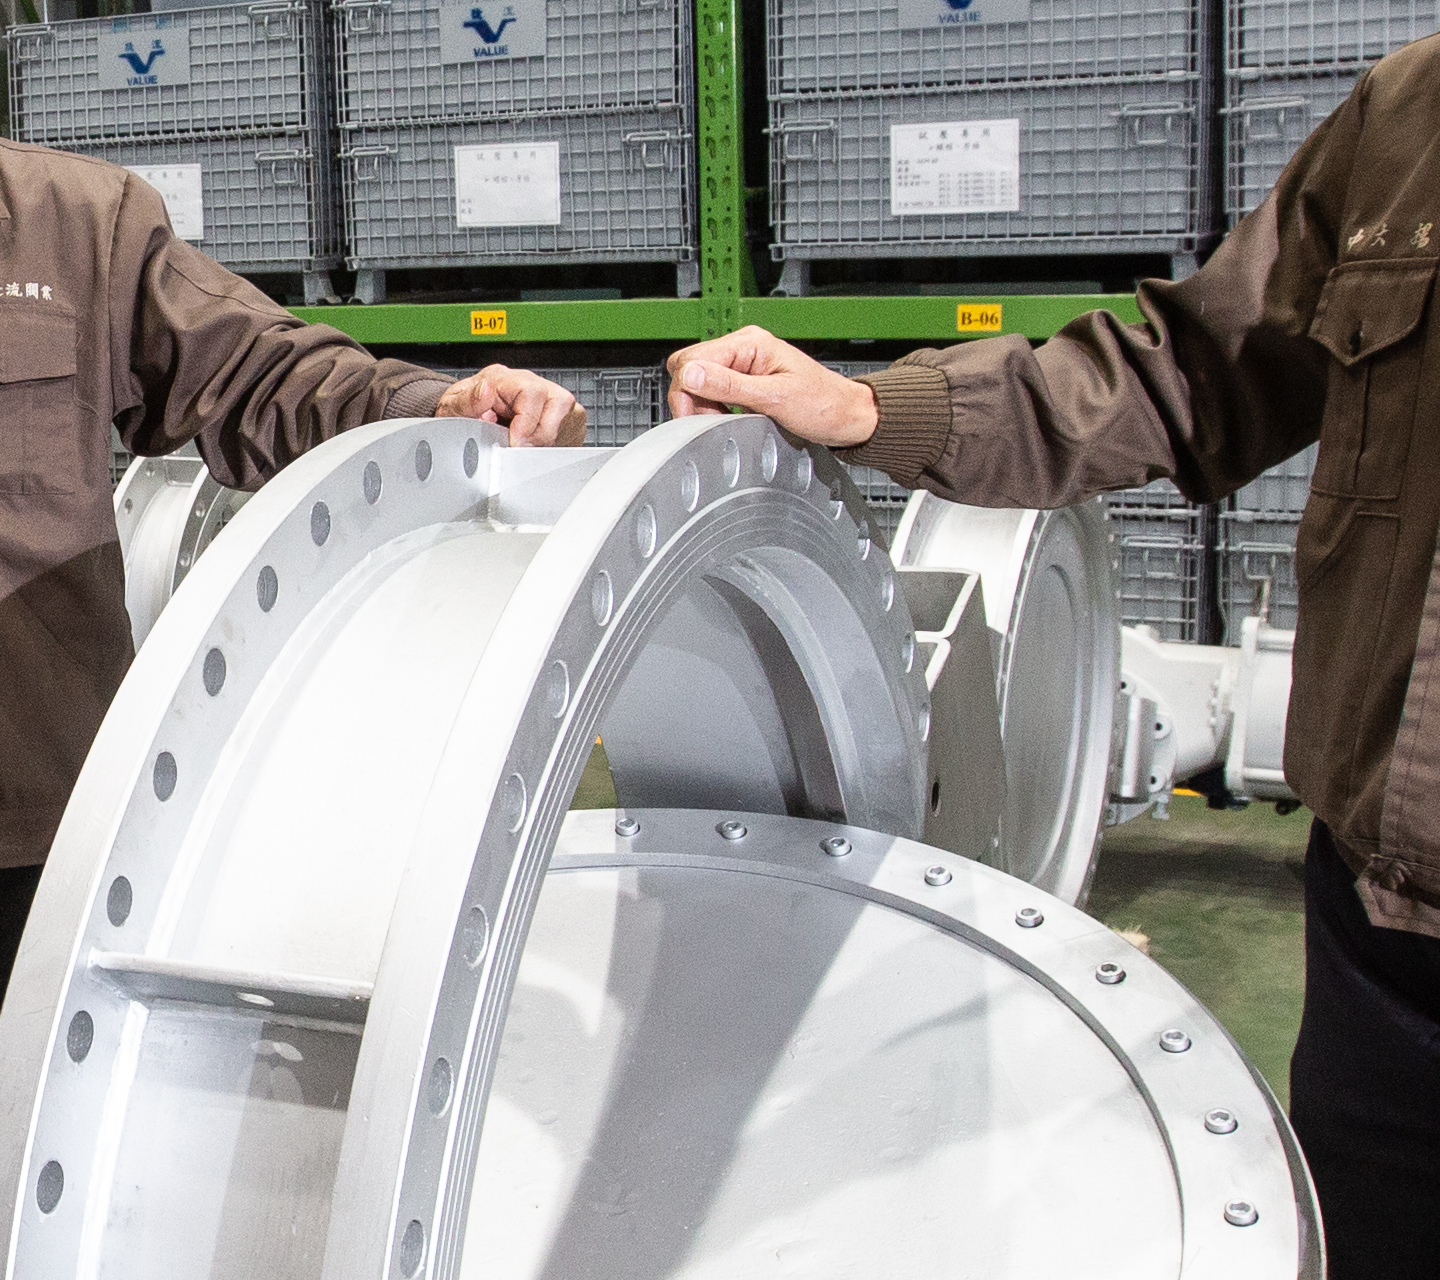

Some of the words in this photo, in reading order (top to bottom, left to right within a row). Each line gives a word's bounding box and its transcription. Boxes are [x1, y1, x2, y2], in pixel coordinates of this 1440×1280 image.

[938, 10, 980, 25] VALUE
[473, 44, 509, 58] VALUE
[126, 74, 158, 86] VALUE
[473, 317, 504, 330] B-07
[961, 311, 999, 326] B-06
